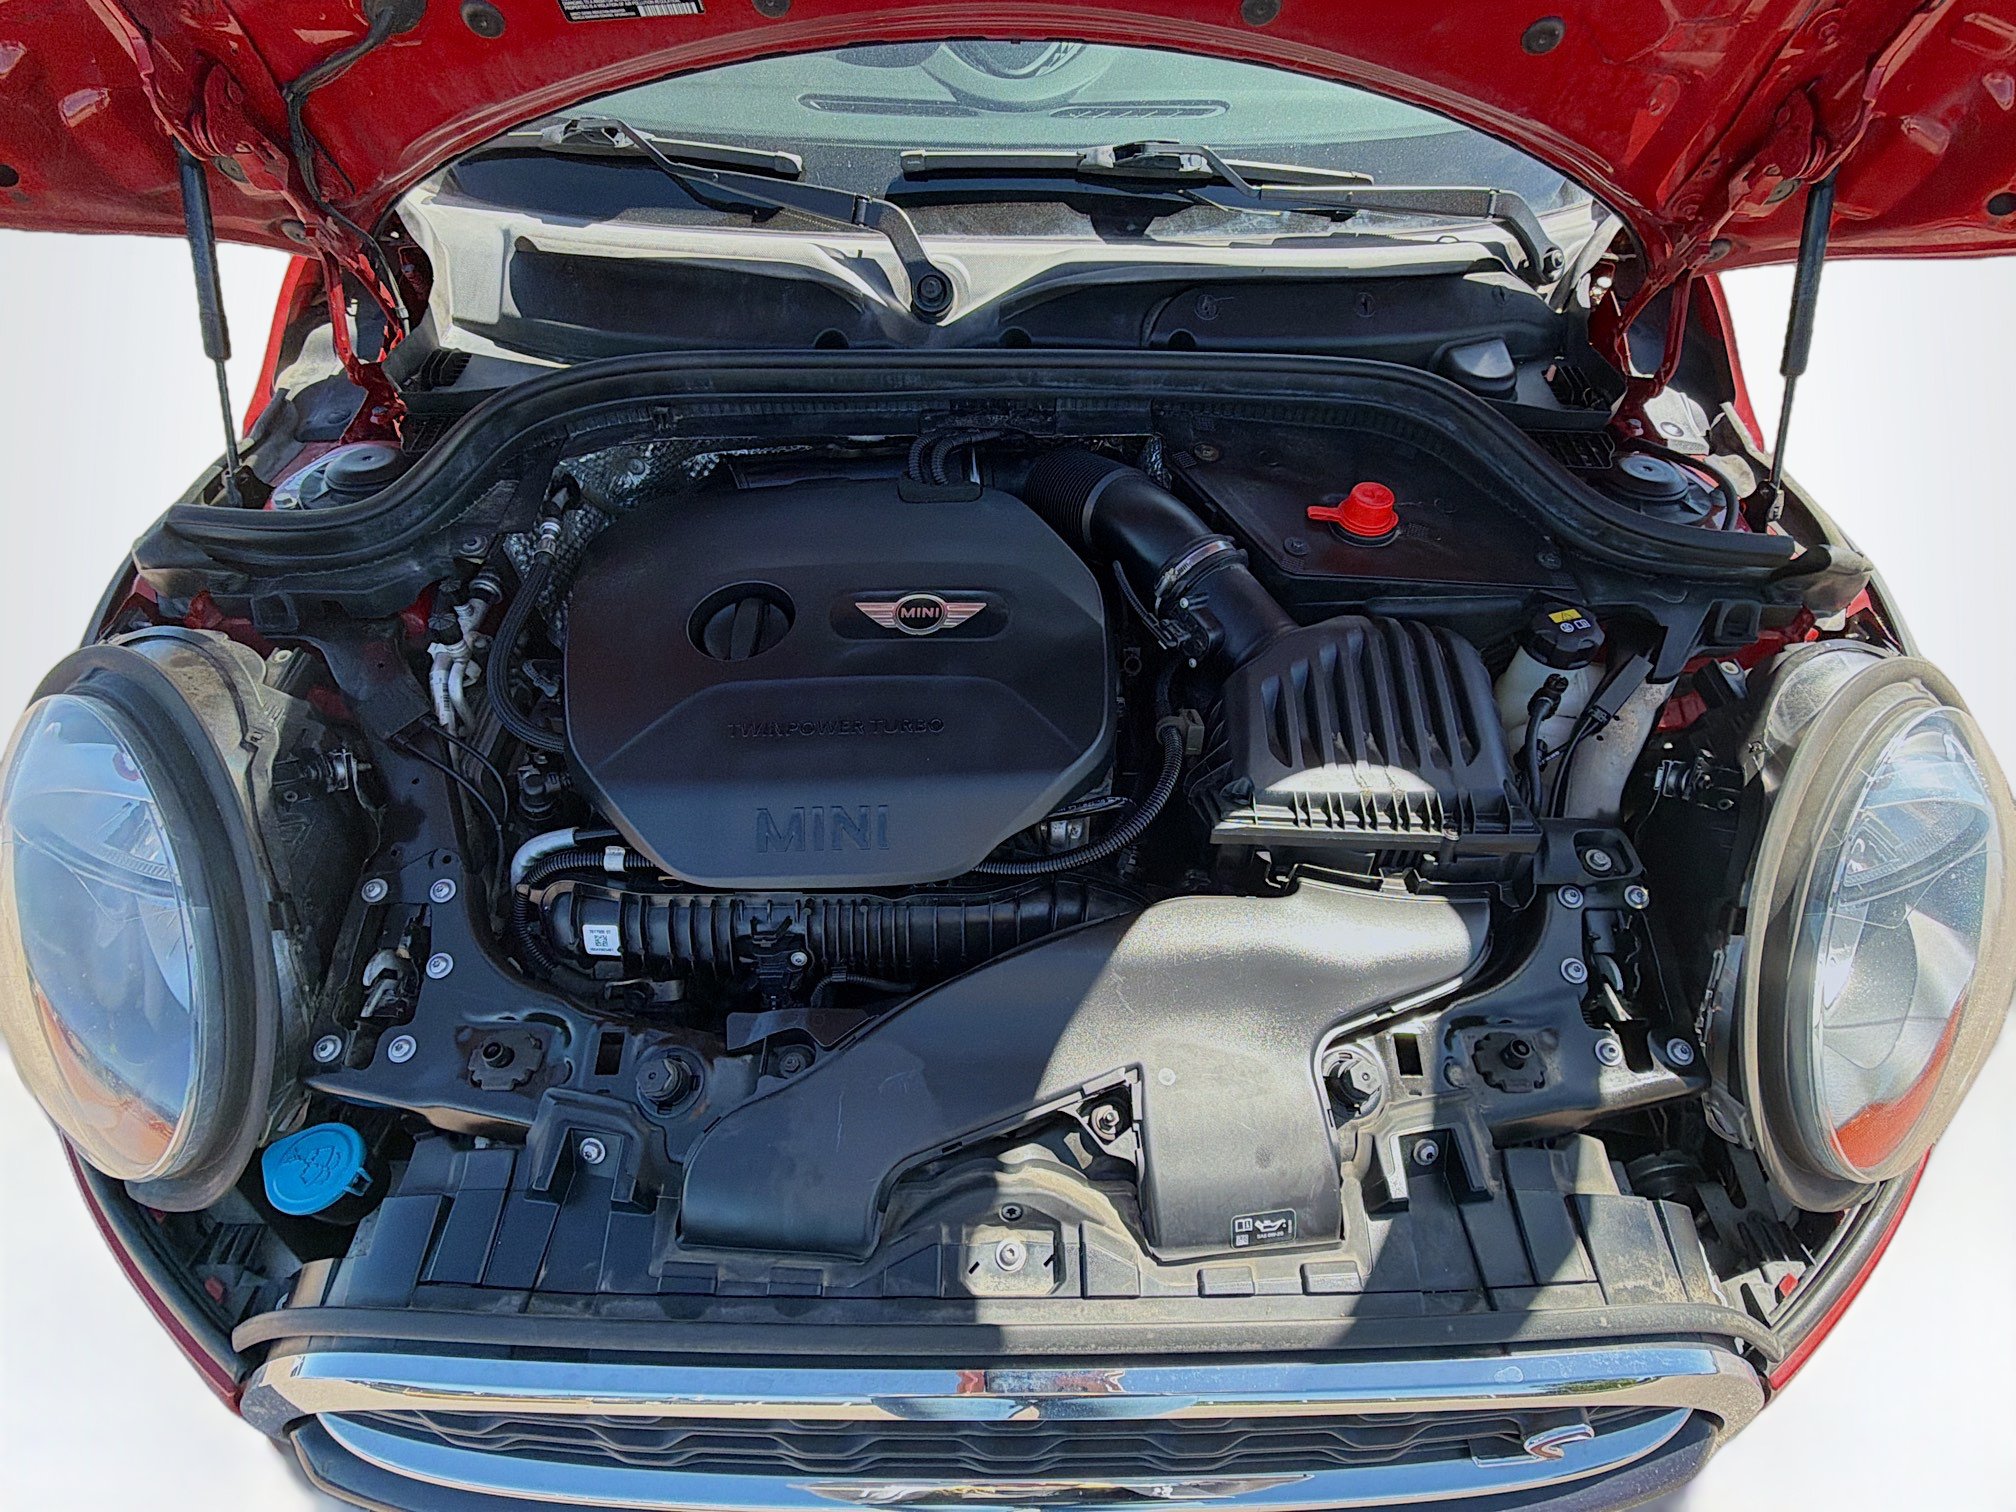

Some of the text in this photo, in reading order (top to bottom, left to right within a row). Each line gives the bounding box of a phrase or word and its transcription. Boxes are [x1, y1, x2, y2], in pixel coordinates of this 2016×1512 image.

[900, 607, 940, 618] MINI
[870, 718, 945, 734] TURBO
[756, 805, 889, 852] MINI
